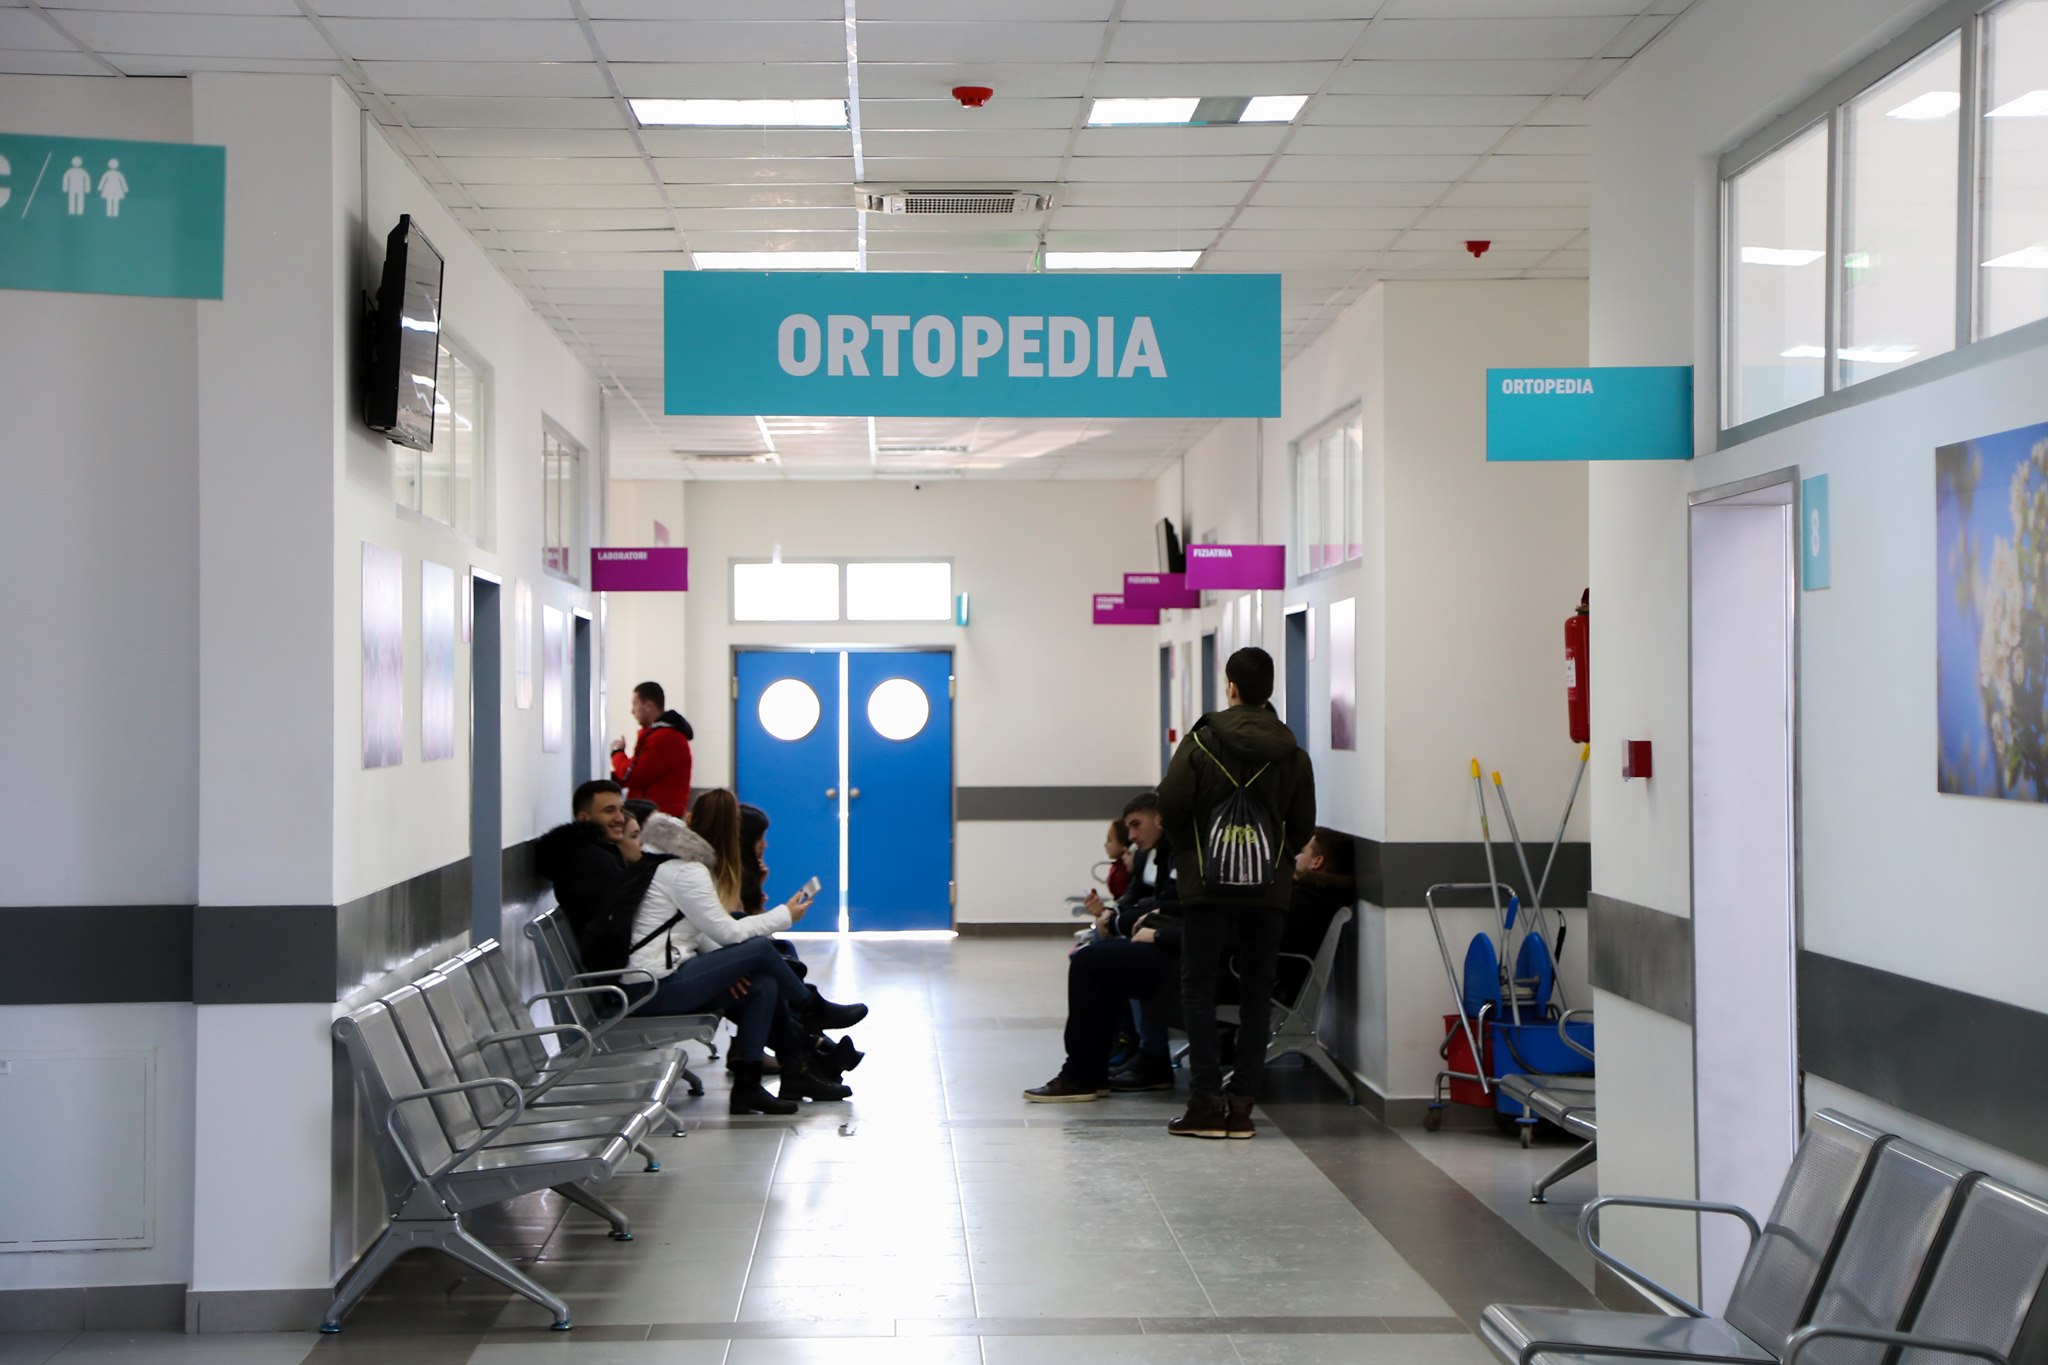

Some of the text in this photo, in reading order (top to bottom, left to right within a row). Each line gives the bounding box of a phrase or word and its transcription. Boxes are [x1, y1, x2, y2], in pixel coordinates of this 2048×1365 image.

[777, 314, 1167, 379] ORTOPEDIA
[1502, 379, 1594, 394] ORTOPEDIA
[1811, 508, 1820, 557] 8
[597, 551, 647, 561] LABORATORI
[1193, 549, 1233, 557] FIZIATRIA
